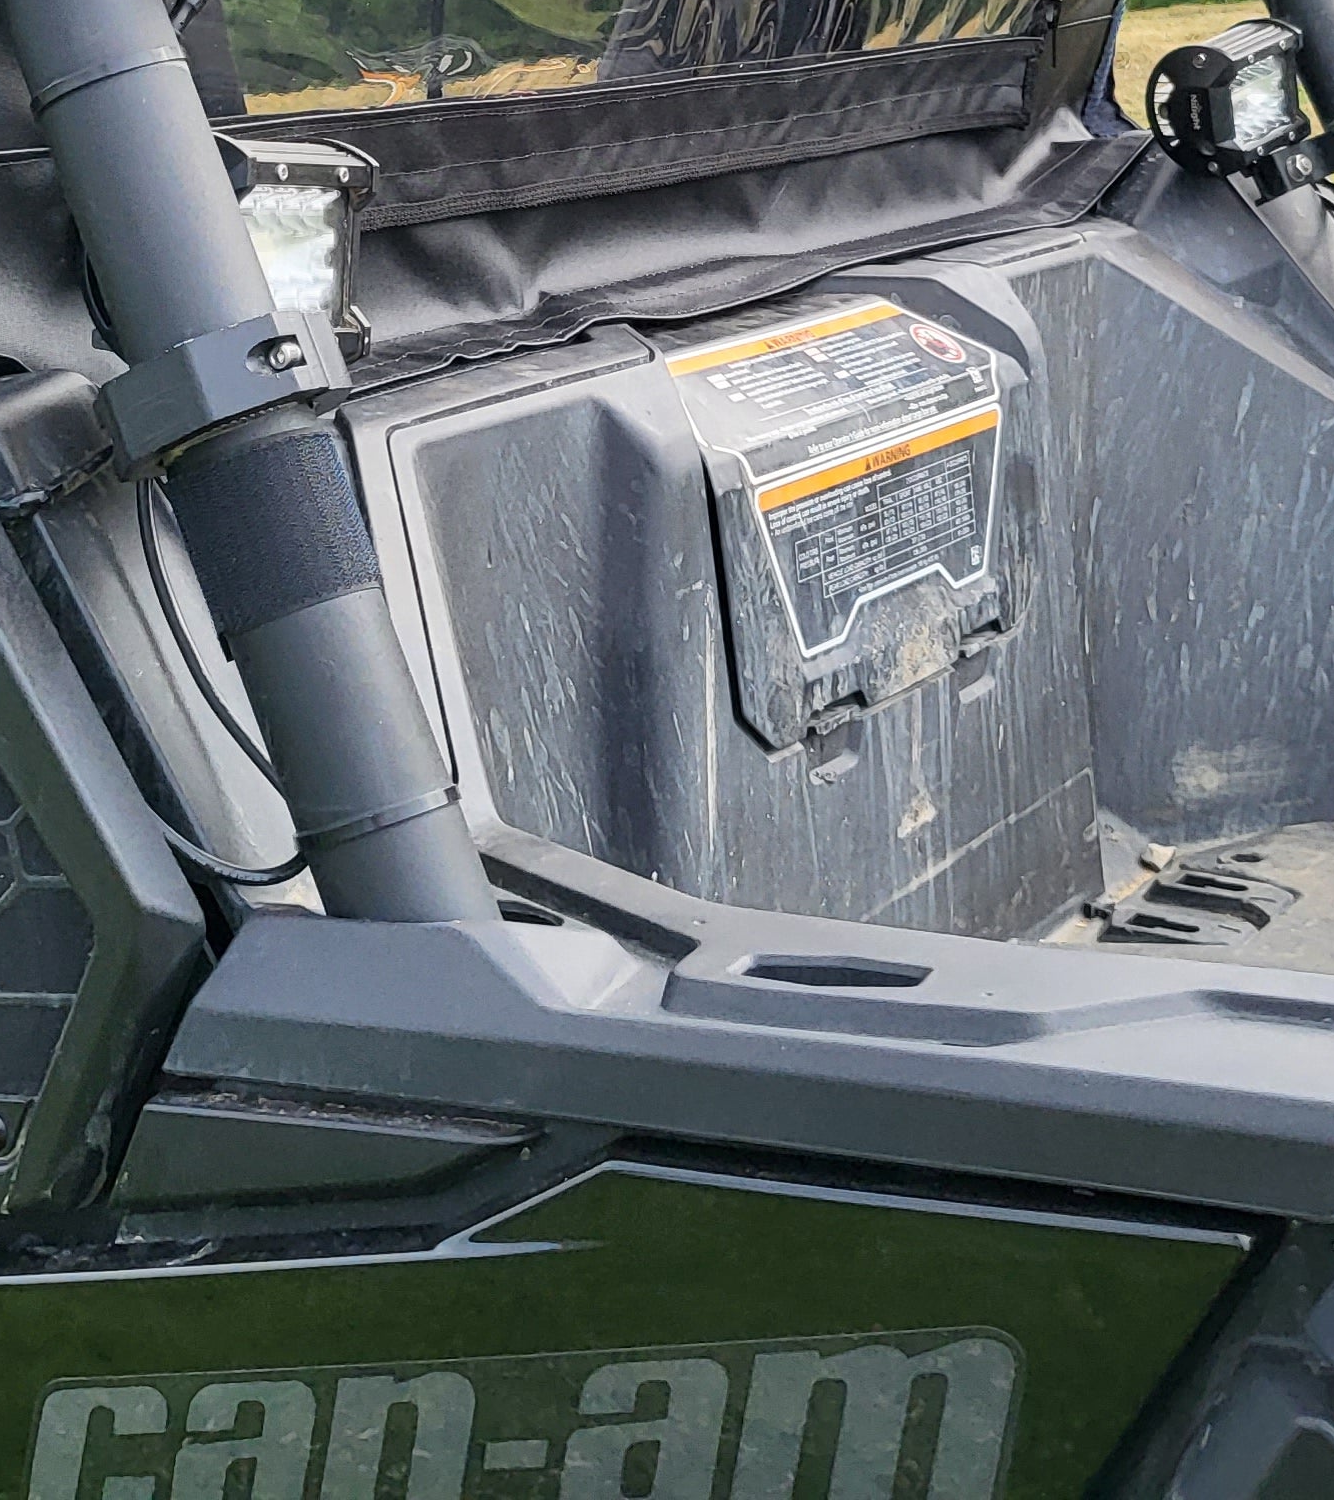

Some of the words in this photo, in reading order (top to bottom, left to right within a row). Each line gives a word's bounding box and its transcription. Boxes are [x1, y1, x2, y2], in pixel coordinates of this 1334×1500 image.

[771, 330, 816, 348] WARNING
[873, 443, 910, 467] WARNING
[28, 1336, 1015, 1500] can-am
